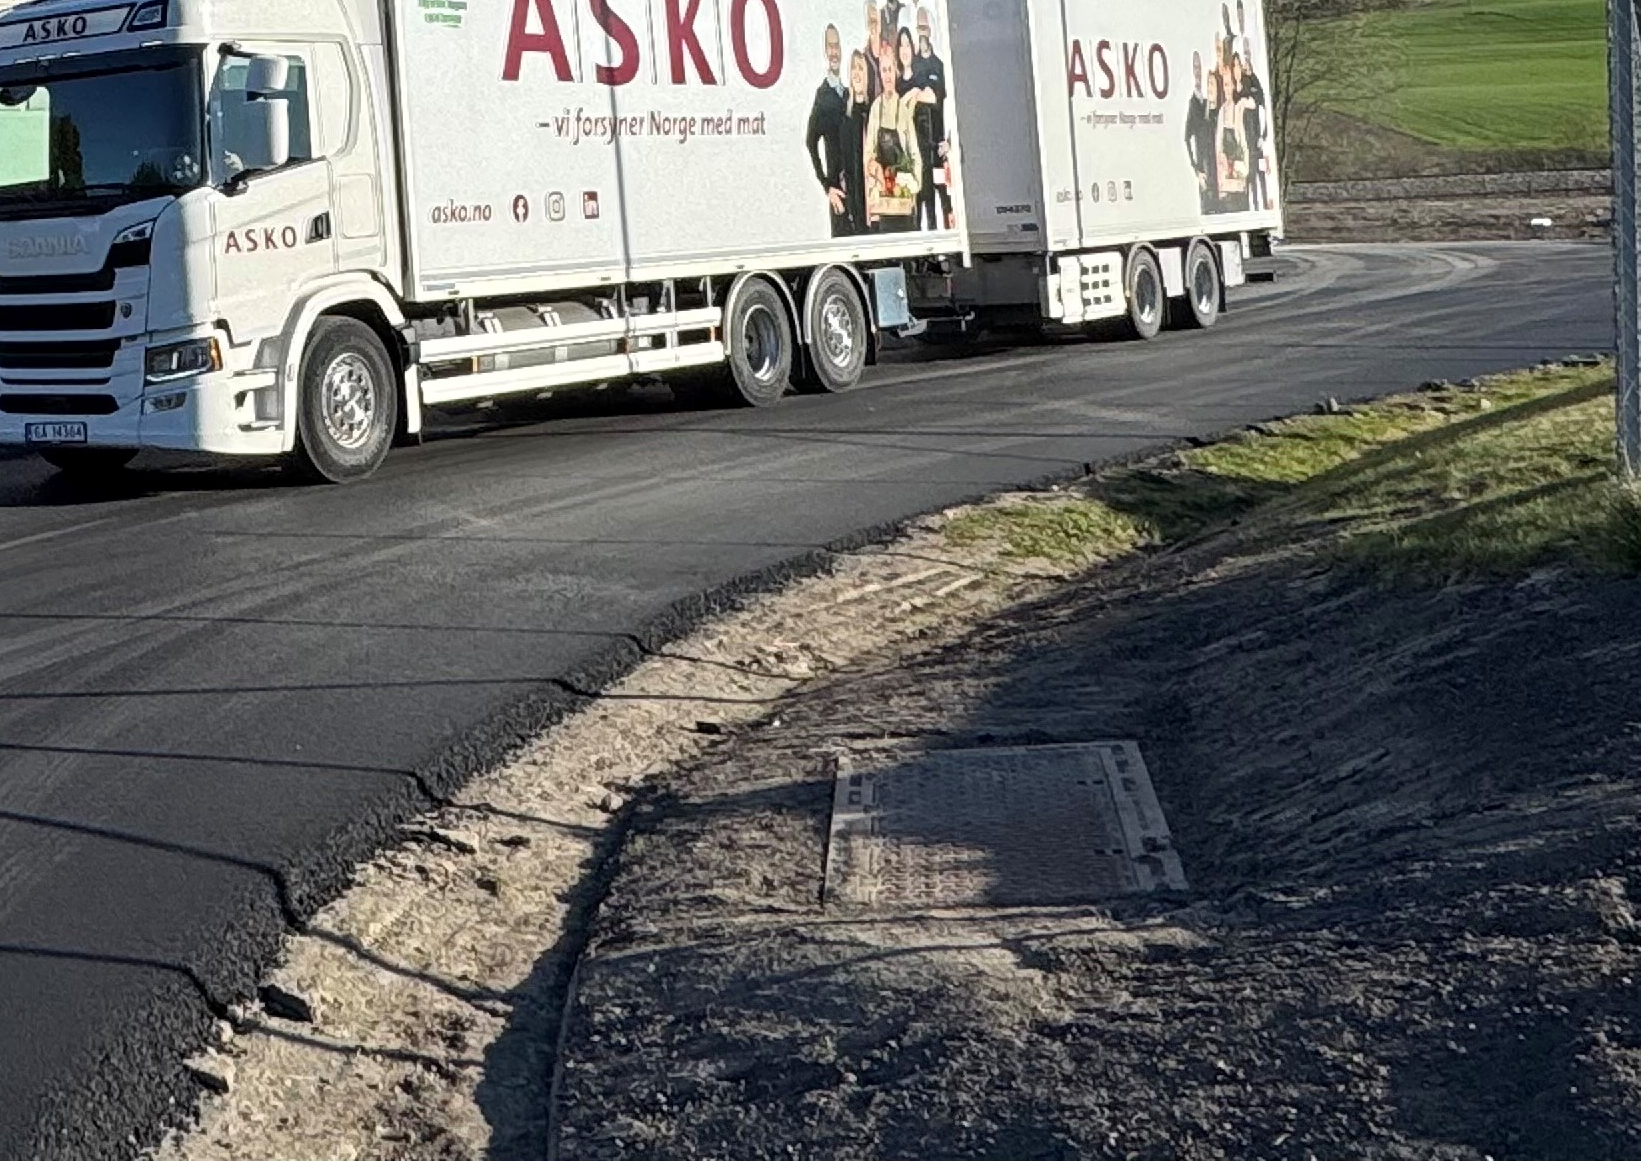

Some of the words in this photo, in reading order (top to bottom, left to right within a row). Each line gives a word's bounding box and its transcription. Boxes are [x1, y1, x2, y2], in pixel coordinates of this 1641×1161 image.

[23, 16, 88, 43] ASKO
[1068, 38, 1170, 100] ASKO
[554, 107, 570, 137] vi
[571, 107, 645, 145] forsyner
[647, 110, 697, 144] Norge
[700, 108, 733, 136] med
[736, 110, 766, 136] mat
[431, 198, 493, 224] asko.no
[224, 225, 298, 254] ASKO
